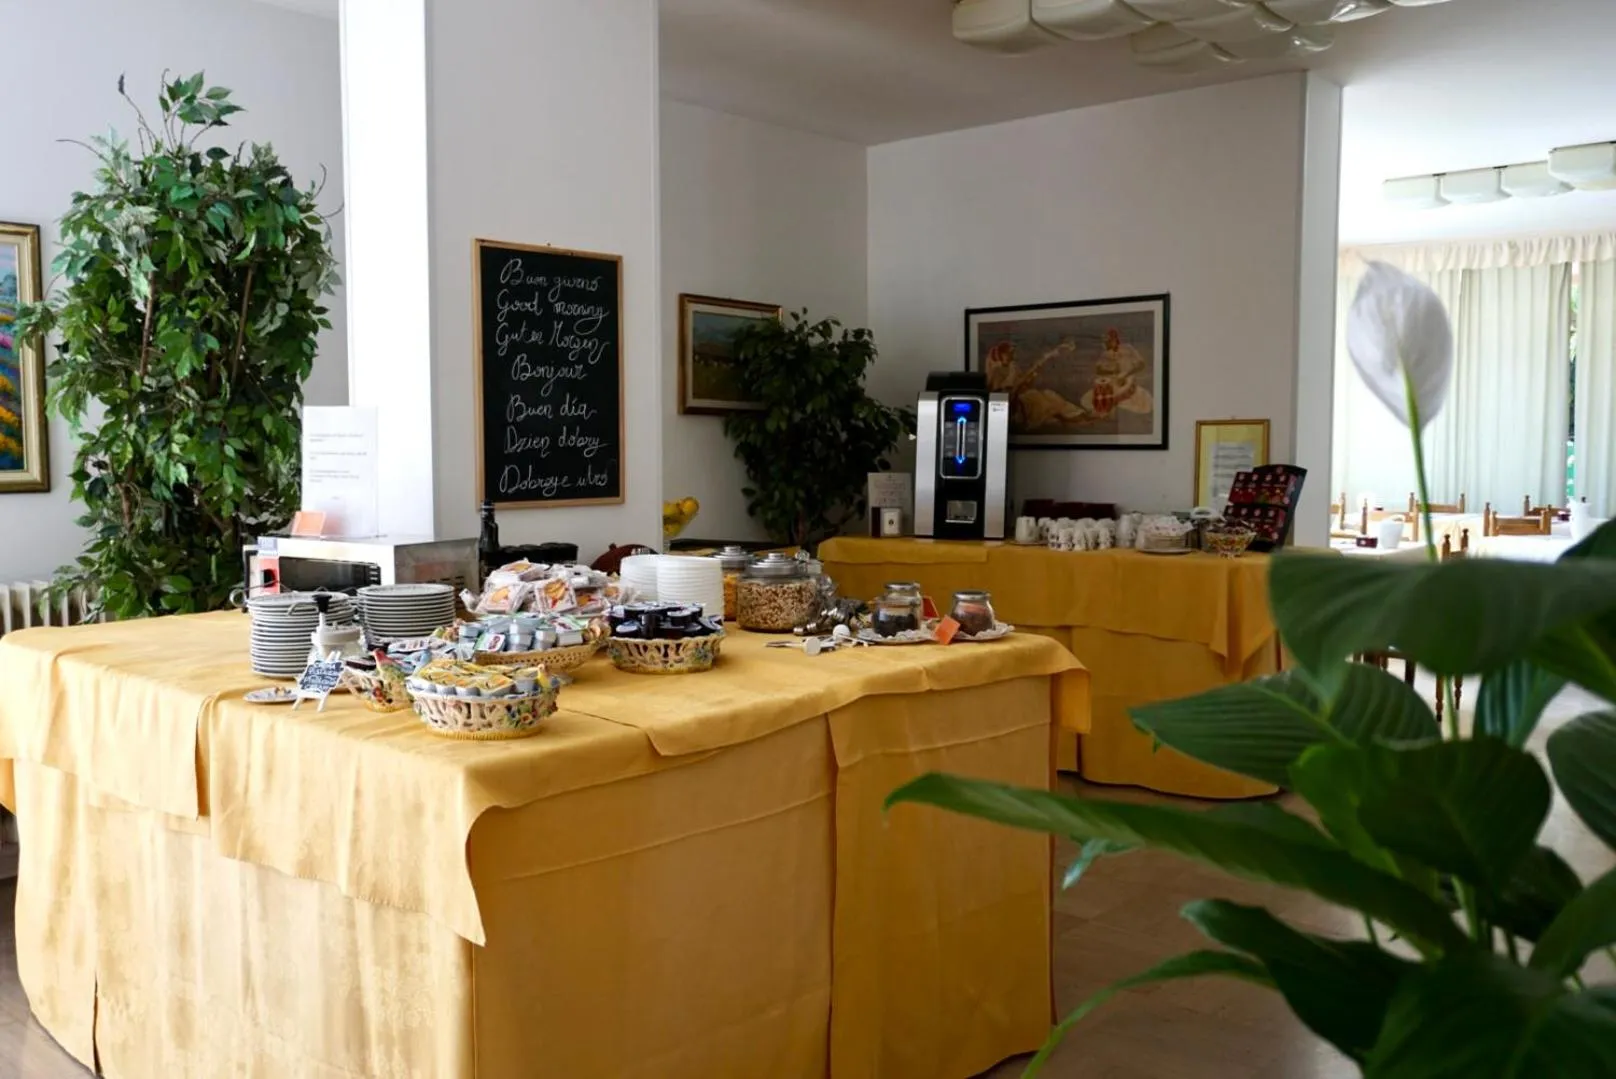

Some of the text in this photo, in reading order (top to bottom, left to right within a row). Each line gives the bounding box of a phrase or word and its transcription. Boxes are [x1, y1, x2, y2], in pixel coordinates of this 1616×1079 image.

[497, 288, 610, 335] Good morning
[495, 320, 610, 364] Guten Morgen
[511, 353, 587, 397] Bonjour
[506, 394, 553, 422] Buen
[558, 425, 609, 457] dobry
